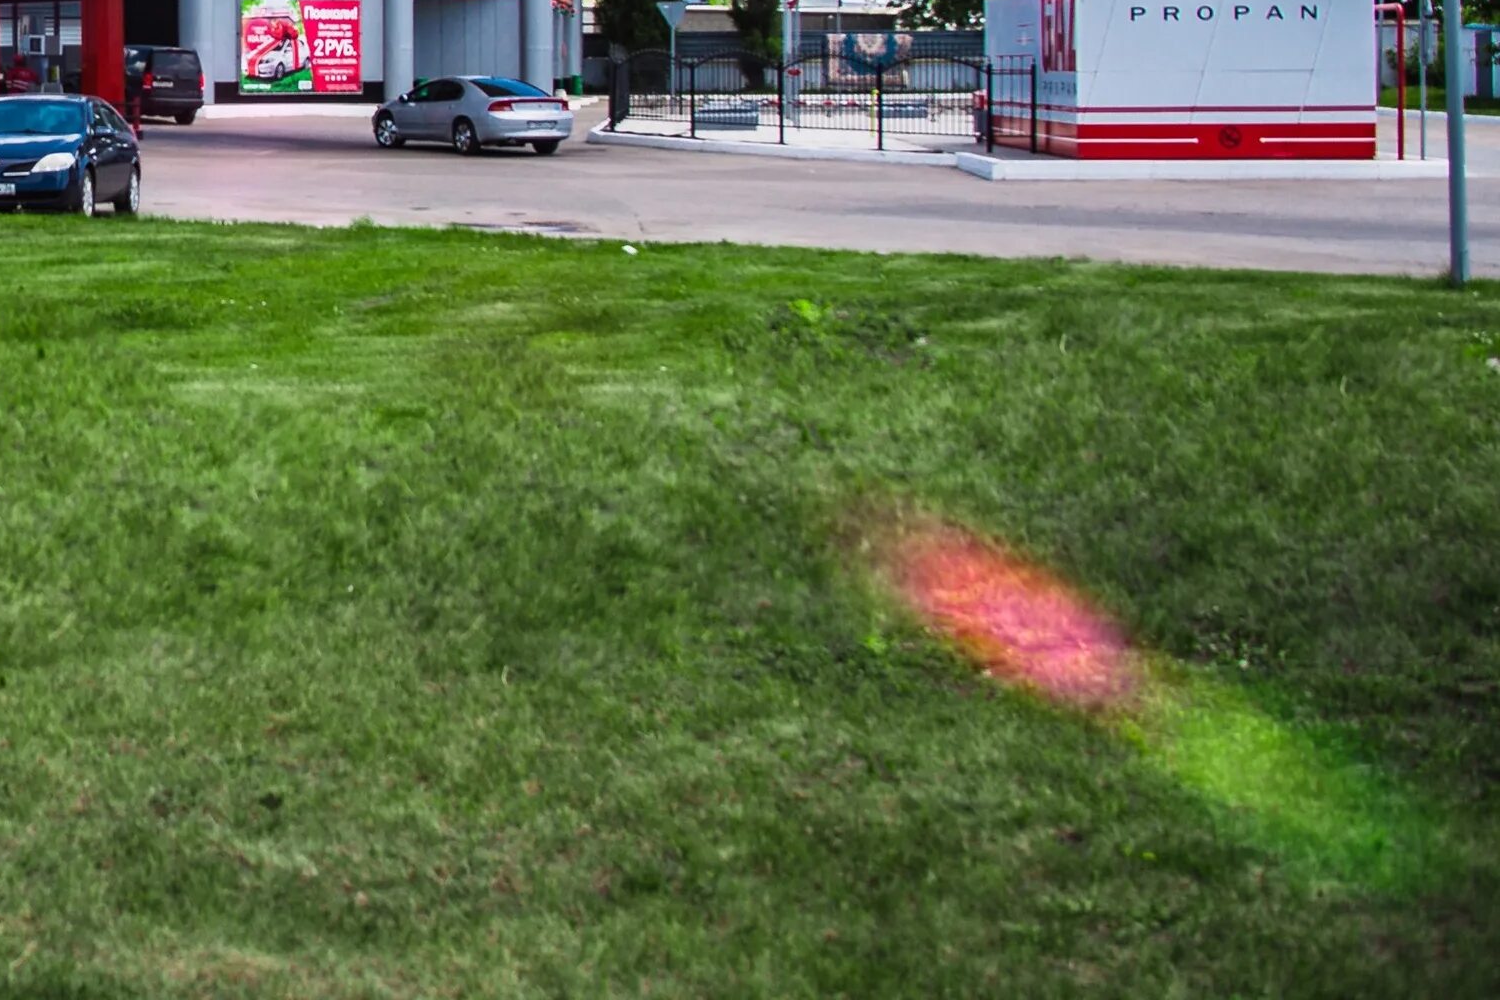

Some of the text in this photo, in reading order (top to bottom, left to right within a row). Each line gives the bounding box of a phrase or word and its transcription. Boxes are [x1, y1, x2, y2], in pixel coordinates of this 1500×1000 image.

[1130, 5, 1318, 21] PROPAN
[313, 38, 357, 57] 2 РУБ.
